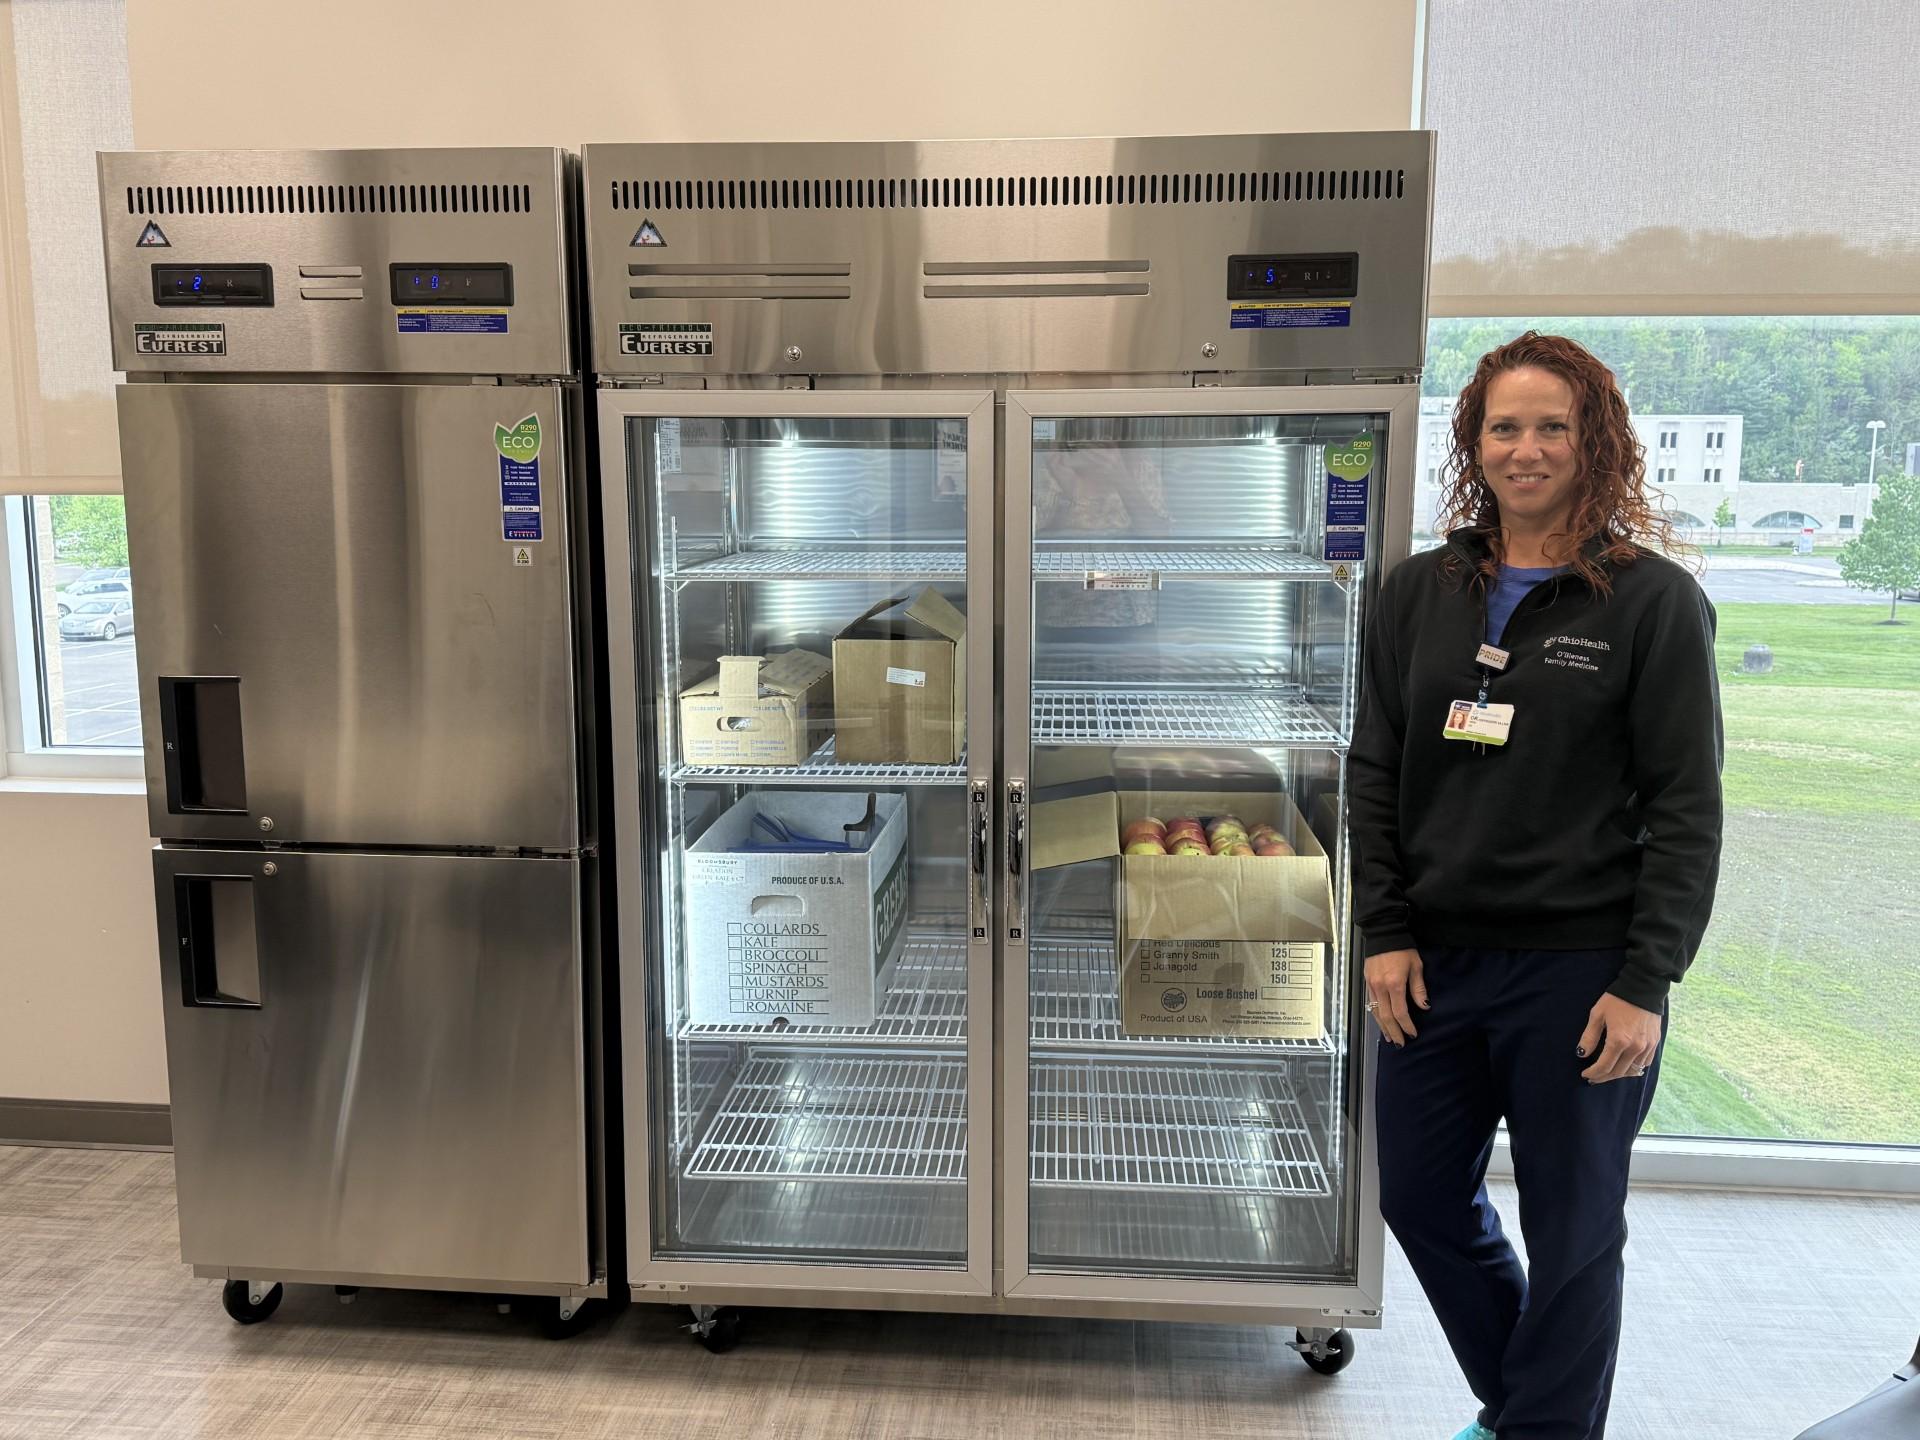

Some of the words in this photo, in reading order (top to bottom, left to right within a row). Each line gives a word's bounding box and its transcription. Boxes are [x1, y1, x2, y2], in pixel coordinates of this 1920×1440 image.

[137, 334, 221, 353] EVEREST
[621, 334, 710, 354] EVEREST
[502, 436, 535, 449] ECO
[1353, 440, 1372, 448] R290
[1332, 453, 1367, 466] ECO
[1557, 636, 1611, 651] OhioHealth
[1478, 648, 1506, 664] PRIDE
[1544, 657, 1567, 667] Family
[1568, 660, 1599, 671] Medicine
[771, 876, 808, 885] PRODUCE
[809, 877, 819, 885] OF
[820, 877, 845, 885] U.S.A.
[743, 922, 820, 935] COLLARDS
[744, 936, 778, 948] KALE
[744, 949, 819, 961] BROCCOLI
[1153, 950, 1189, 961] Granny
[1191, 951, 1220, 960] Smith
[1271, 948, 1288, 958] 125
[744, 962, 808, 974] SPINACH
[1153, 962, 1198, 973] Jonagold
[1271, 961, 1287, 971] 138
[745, 975, 824, 987] MUSTARDS
[1270, 974, 1287, 984] 150
[745, 988, 799, 1000] TURNIP
[1196, 988, 1224, 999] Loose
[1226, 988, 1258, 1000] Bushel
[746, 1001, 814, 1013] ROMAINE
[1140, 1014, 1174, 1023] Product
[1176, 1014, 1185, 1023] of
[1187, 1015, 1209, 1024] USA
